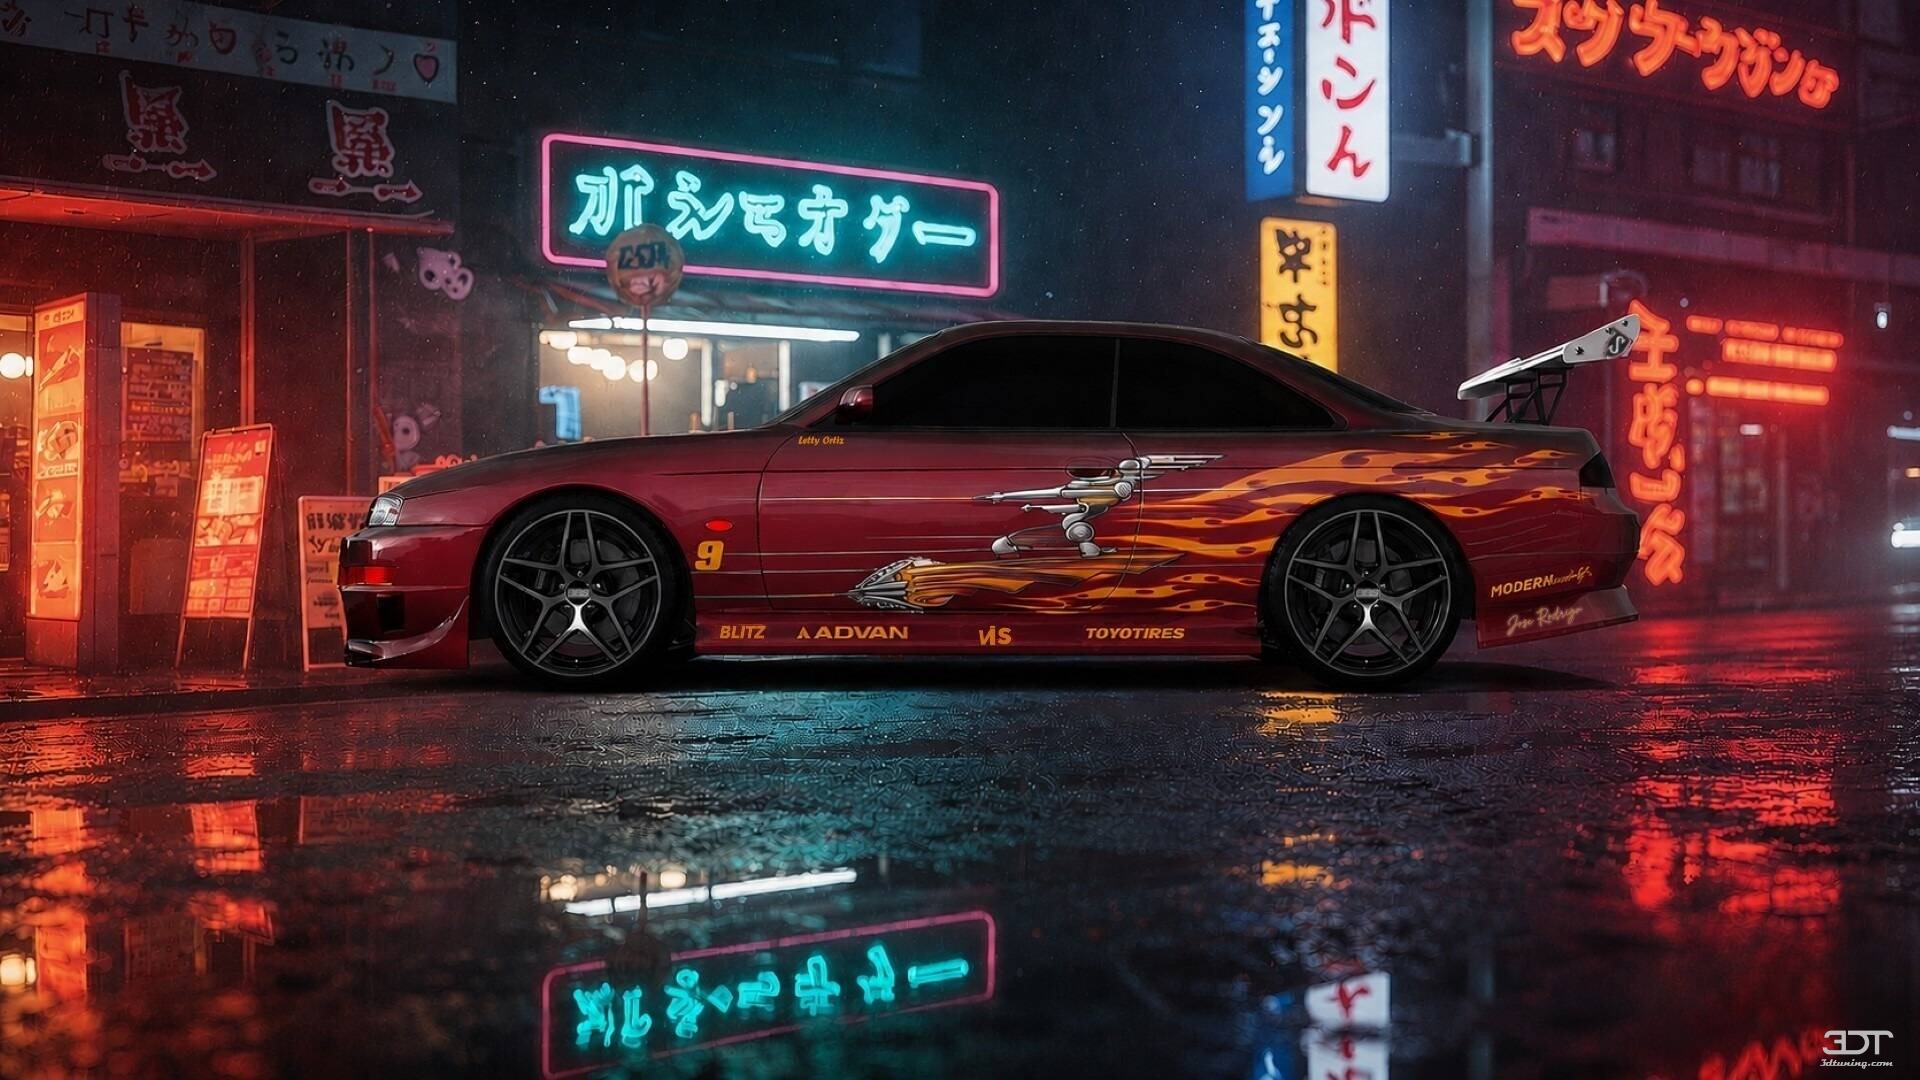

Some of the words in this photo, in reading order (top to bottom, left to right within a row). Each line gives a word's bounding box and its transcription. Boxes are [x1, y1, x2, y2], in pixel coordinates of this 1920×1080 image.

[695, 540, 724, 571] 9
[719, 625, 768, 640] BLITZ
[813, 626, 909, 640] ADVAN
